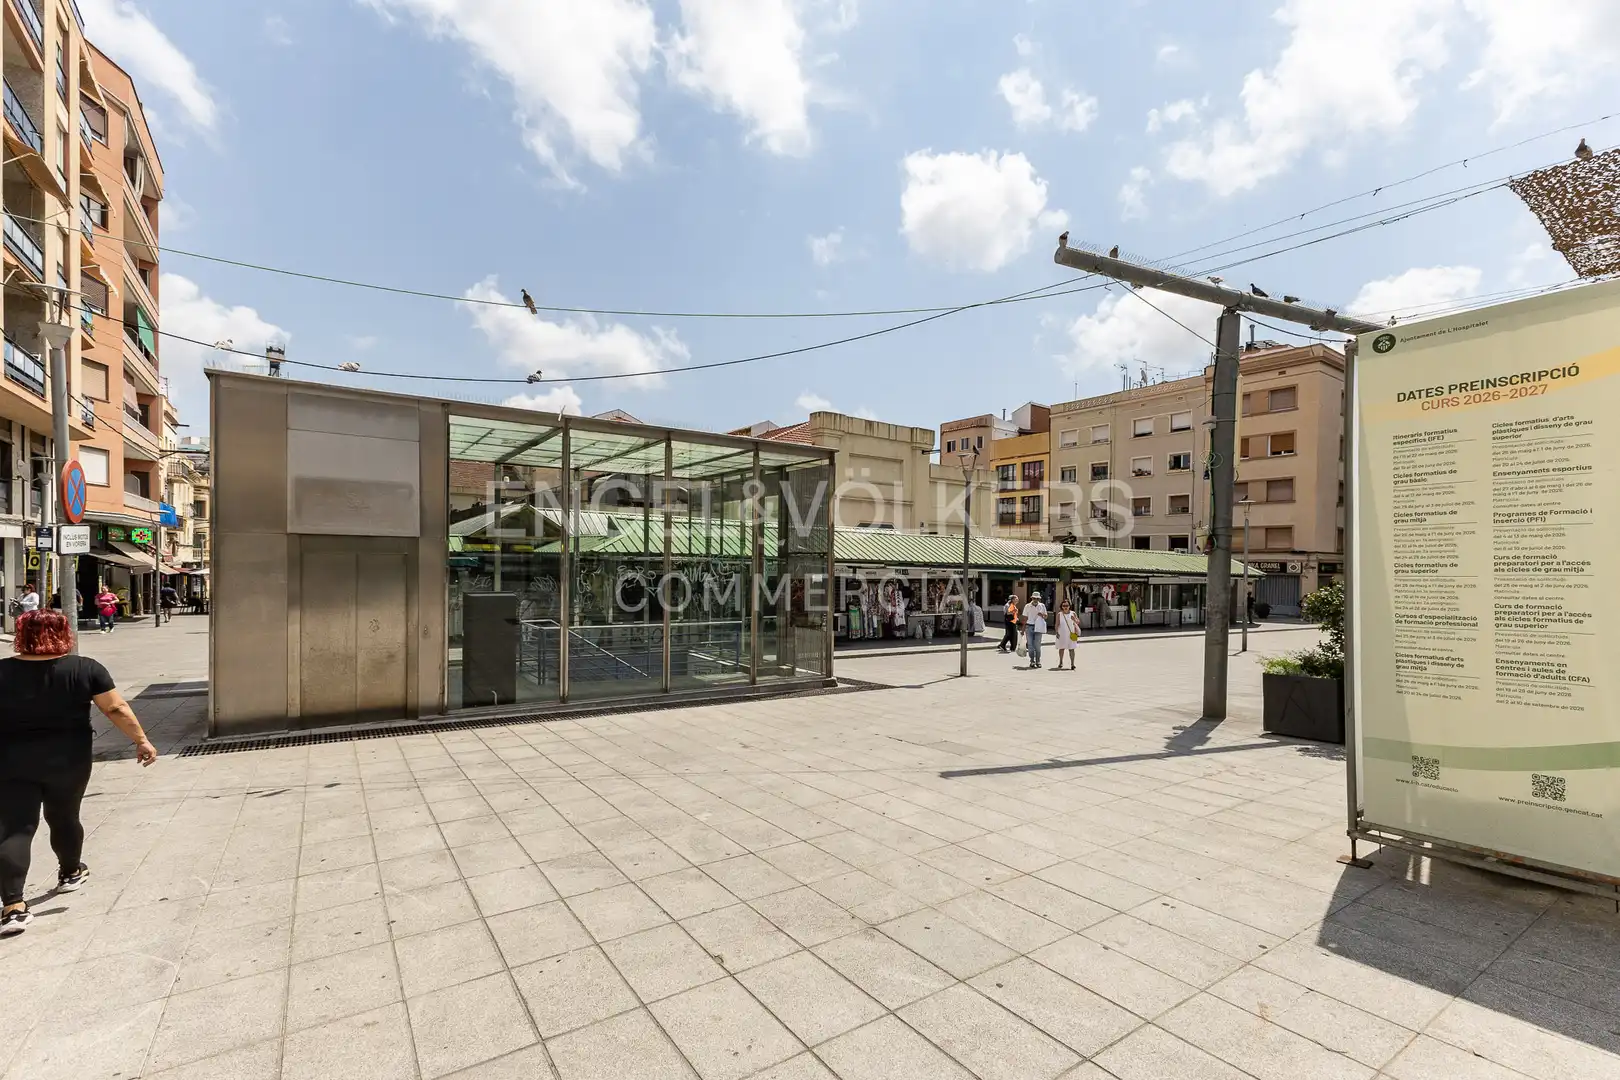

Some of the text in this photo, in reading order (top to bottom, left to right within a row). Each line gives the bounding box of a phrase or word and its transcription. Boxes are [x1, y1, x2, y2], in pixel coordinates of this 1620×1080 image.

[1400, 331, 1436, 343] Ajuntament
[1448, 320, 1489, 333] L'Hospitalet
[1397, 363, 1579, 403] DATES PREINSCRIPCIÓ
[1421, 397, 1460, 411] CURS
[1515, 418, 1549, 426] formatius
[1414, 469, 1447, 477] formatius
[1492, 465, 1592, 477] Ensenyaments esportius
[1533, 616, 1573, 624] formatius
[1431, 661, 1455, 669] disseny
[1495, 657, 1555, 667] Ensenyaments
[1533, 673, 1566, 681] d'adults
[1568, 675, 1591, 683] (CFA)
[1498, 795, 1603, 819] www.preinscripcio.gencat.cat
